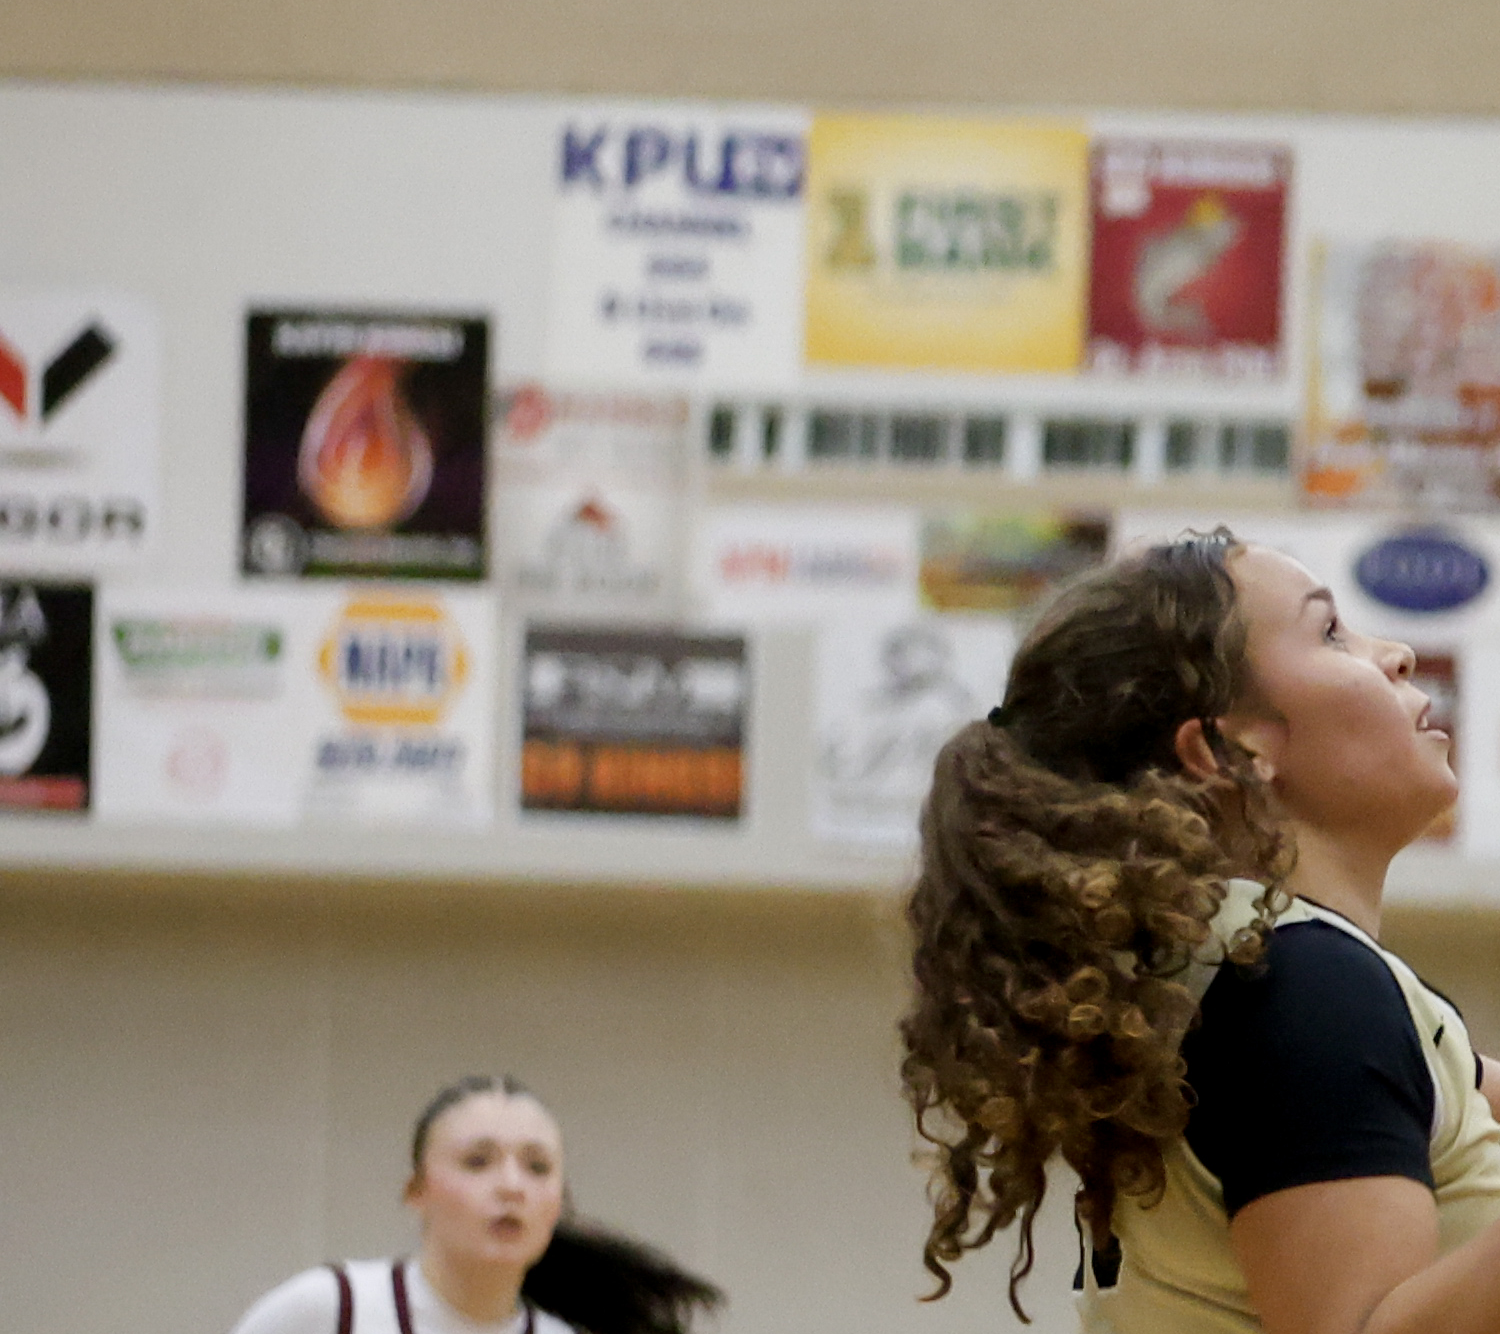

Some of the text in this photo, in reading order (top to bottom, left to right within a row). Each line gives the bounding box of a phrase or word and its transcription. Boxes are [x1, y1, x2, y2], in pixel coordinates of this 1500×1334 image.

[892, 186, 1061, 225] FIRST
[892, 225, 1057, 273] BANK
[341, 629, 450, 699] NAPA
